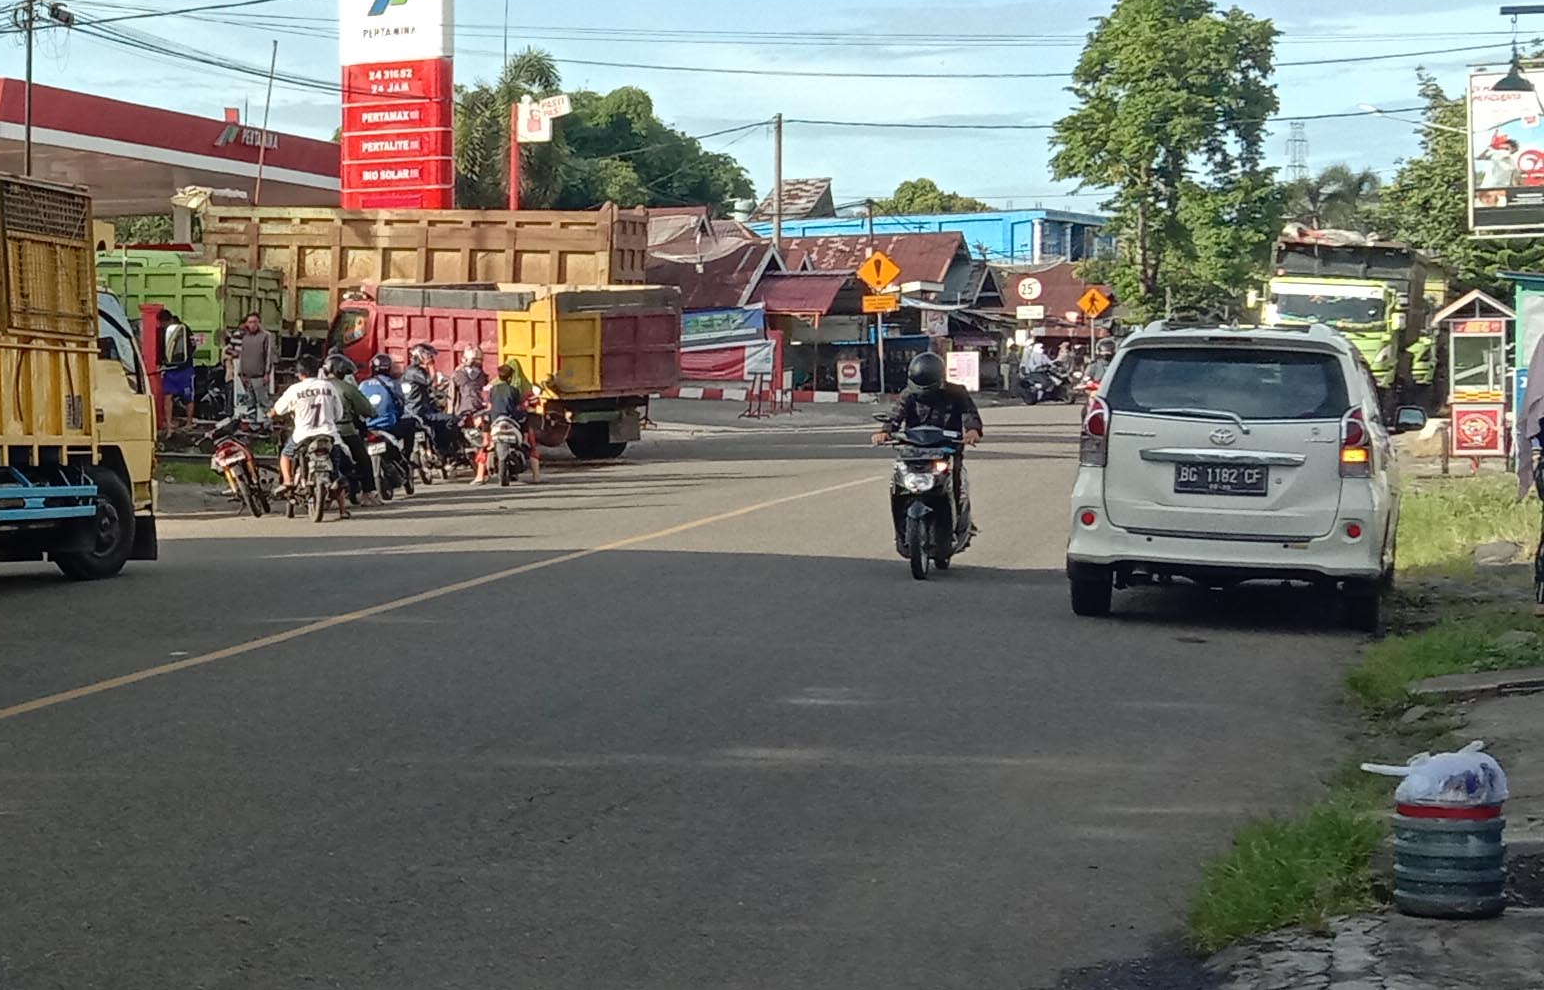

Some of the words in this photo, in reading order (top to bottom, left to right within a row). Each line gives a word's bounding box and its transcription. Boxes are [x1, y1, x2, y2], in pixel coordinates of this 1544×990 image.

[362, 26, 416, 39] PERTAMINA
[368, 70, 383, 81] 24
[387, 81, 410, 93] JAM
[361, 110, 409, 123] PERTAMAX
[361, 140, 409, 153] PERTALITE
[362, 170, 379, 180] BIO
[379, 168, 410, 180] SOLAR
[296, 387, 332, 399] BECKHAM
[311, 403, 322, 428] 7
[1180, 467, 1198, 482] BG
[1207, 468, 1238, 484] 1182
[1244, 469, 1262, 484] CF
